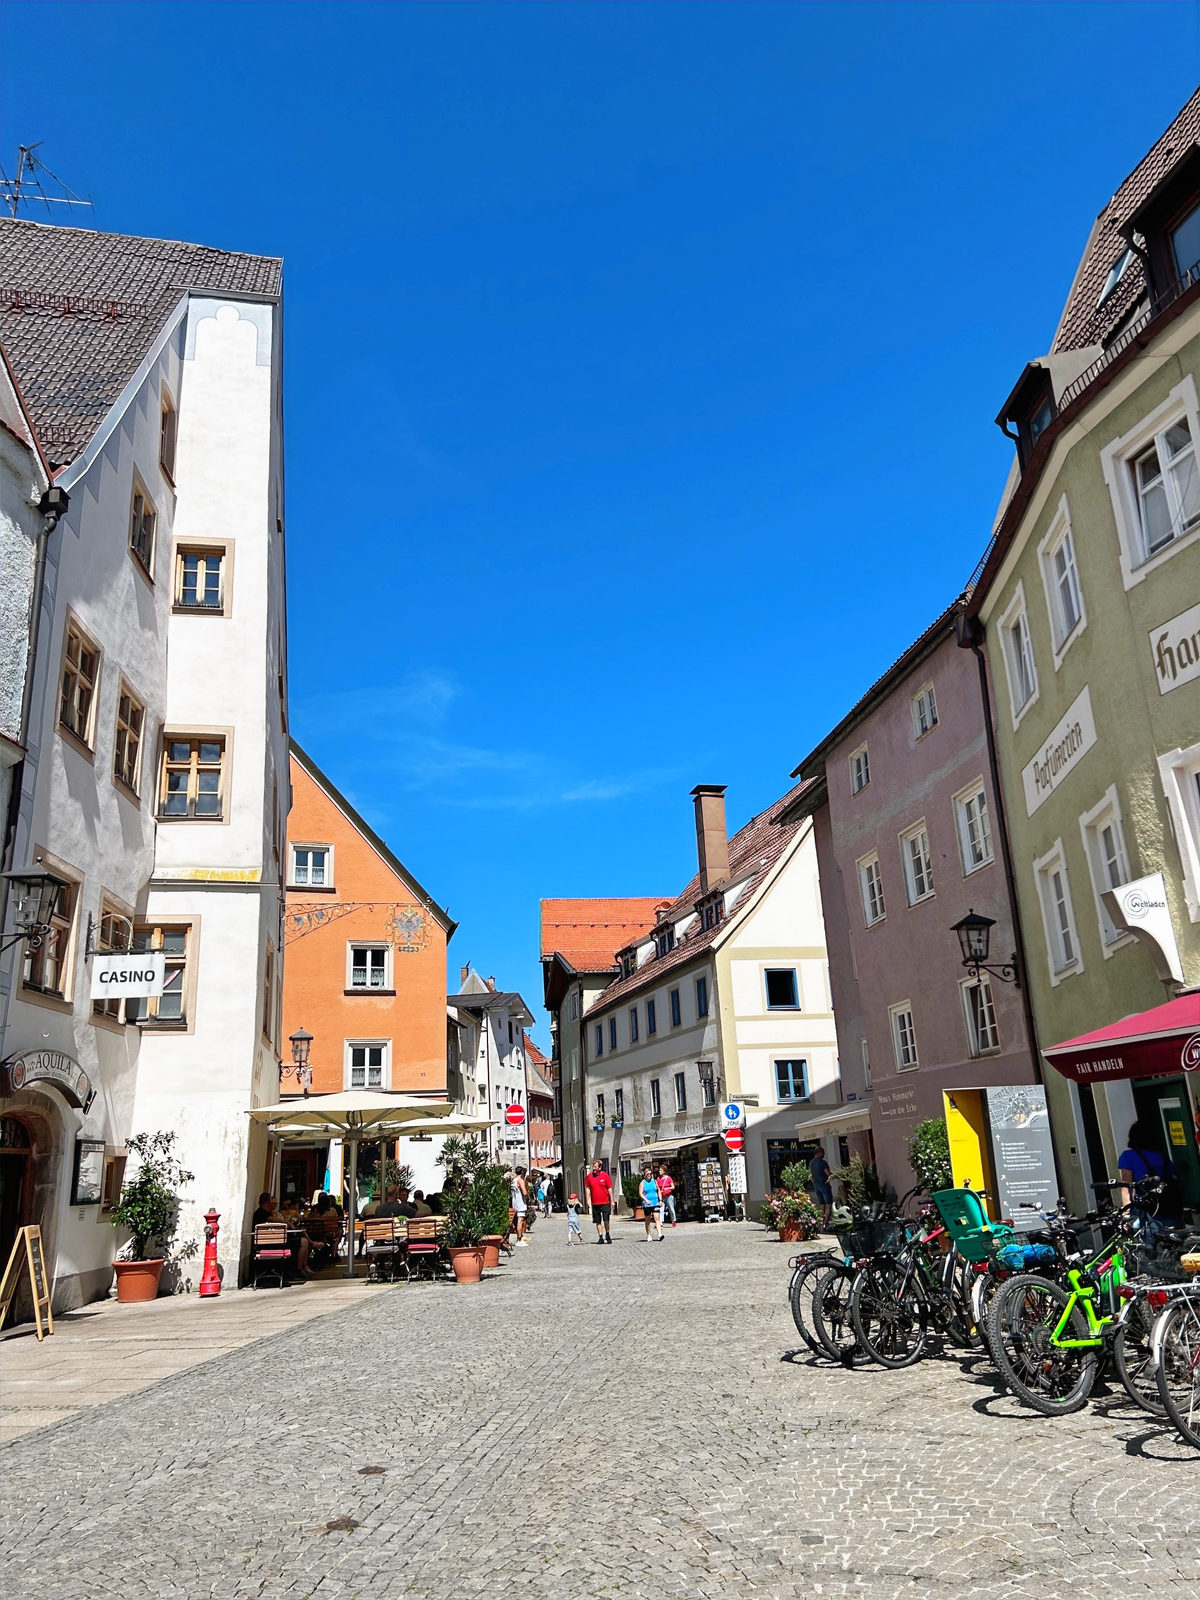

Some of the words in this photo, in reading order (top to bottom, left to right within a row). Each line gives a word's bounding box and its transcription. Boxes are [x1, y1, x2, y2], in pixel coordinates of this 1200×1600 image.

[1131, 899, 1166, 909] Weltladen
[99, 969, 156, 984] CASINO
[35, 1053, 71, 1075] AQUILA
[1076, 1062, 1093, 1075] FAIR
[1093, 1057, 1124, 1073] HANDELN
